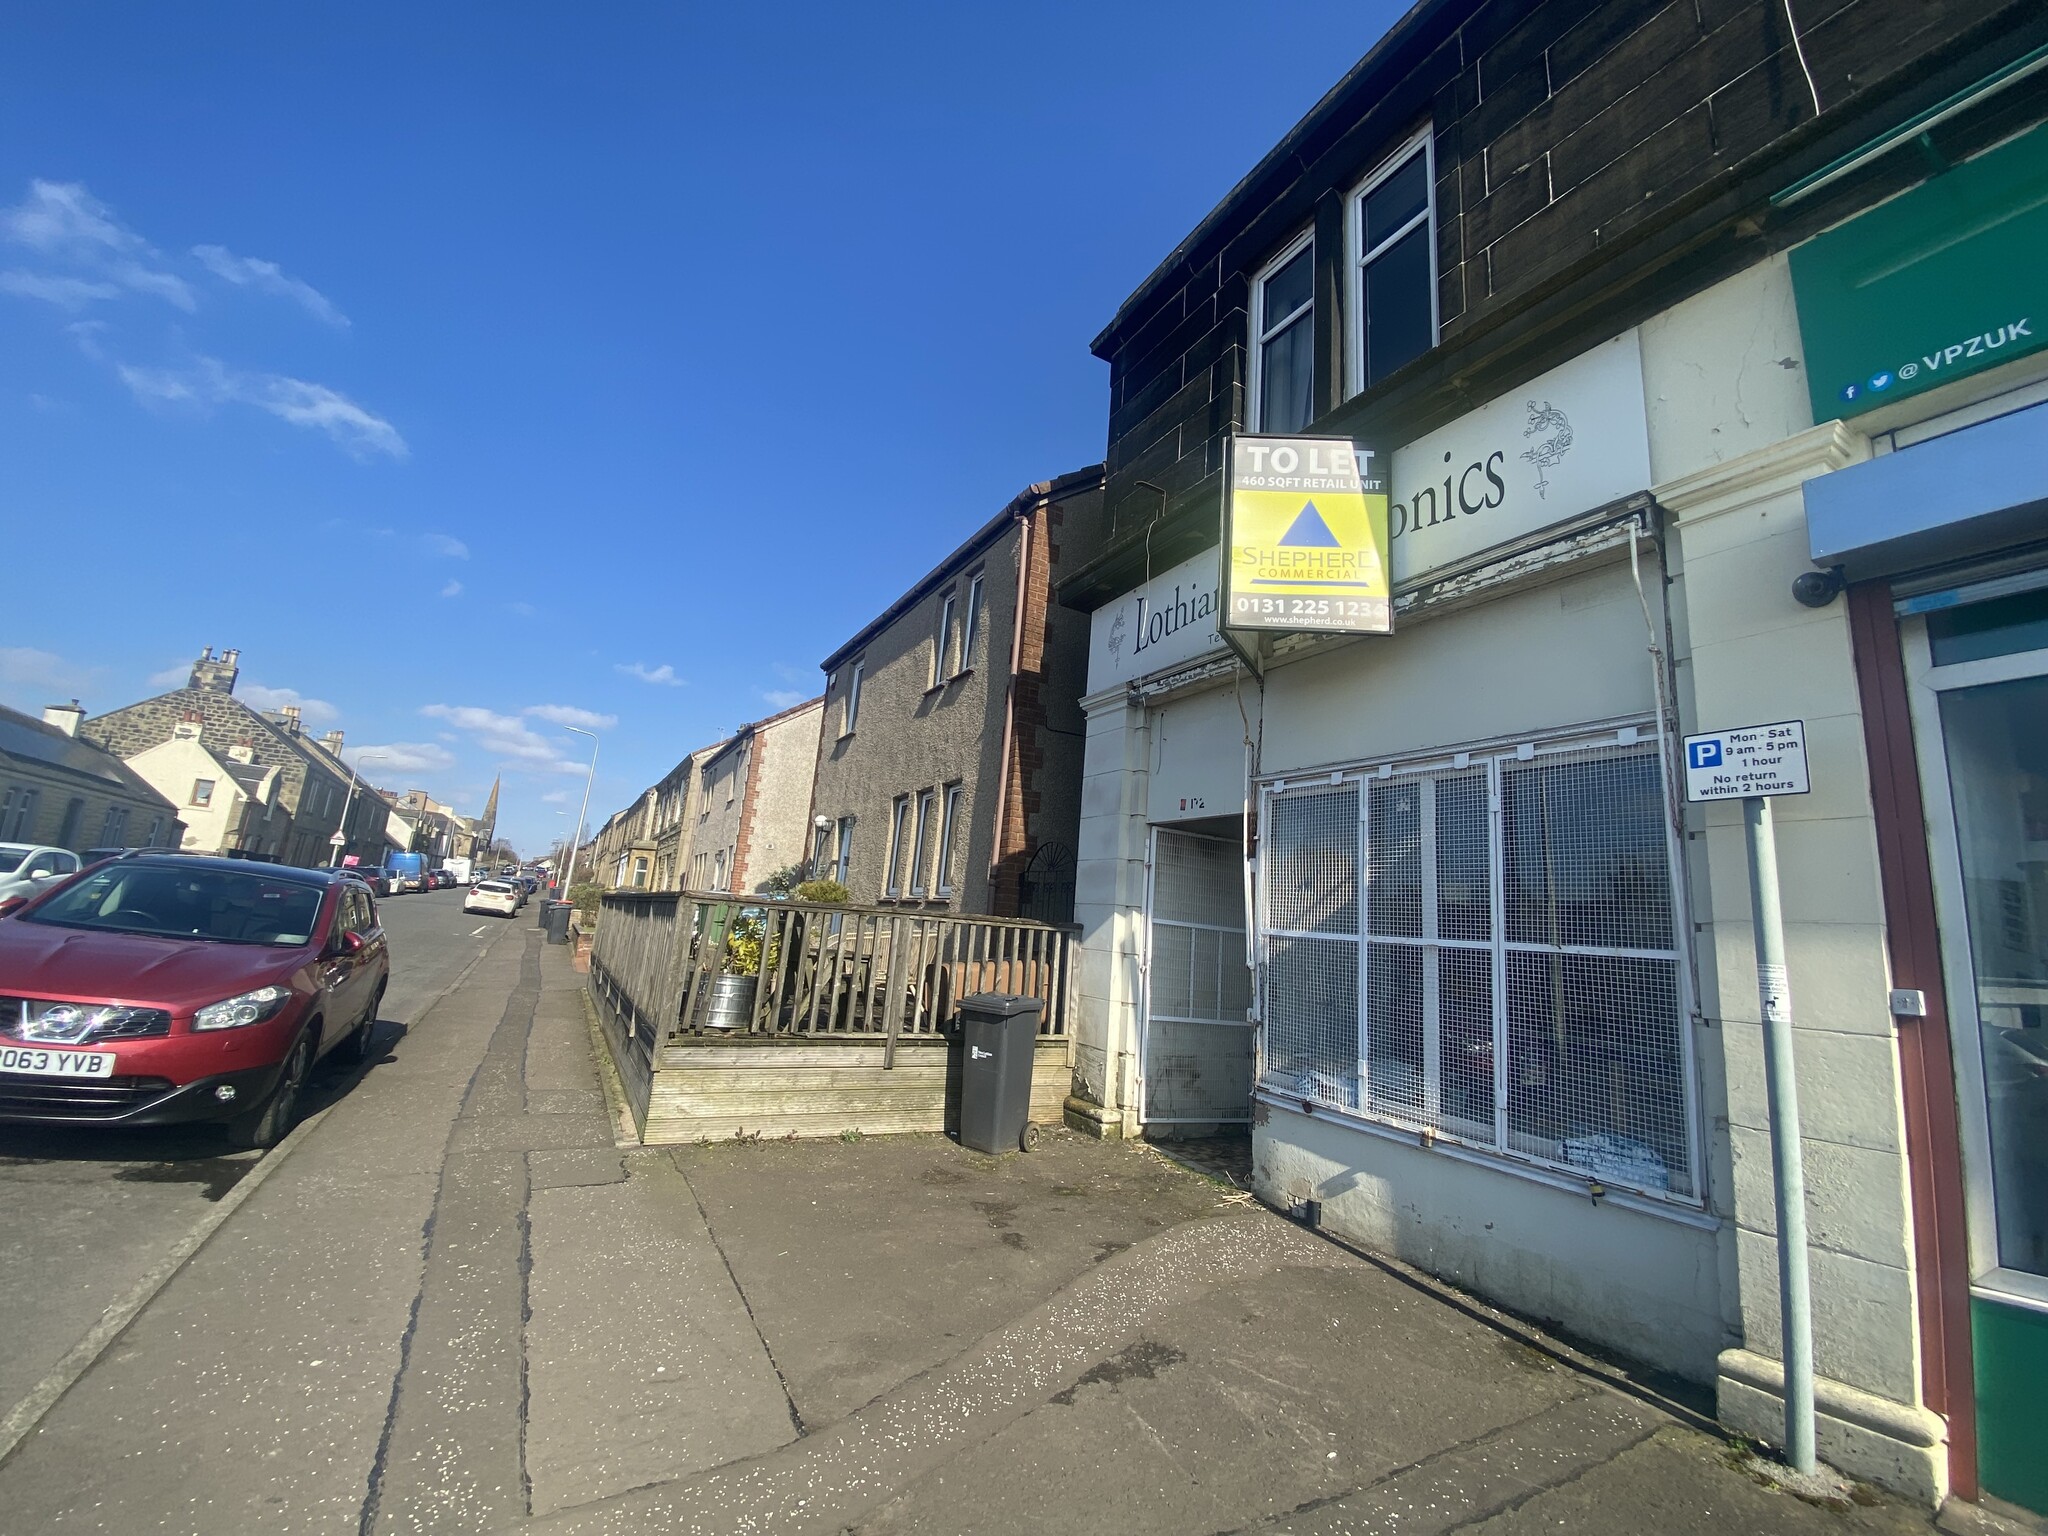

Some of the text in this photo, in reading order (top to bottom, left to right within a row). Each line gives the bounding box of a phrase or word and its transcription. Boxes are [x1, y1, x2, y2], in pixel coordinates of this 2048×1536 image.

[1247, 446, 1375, 476] TO LET
[1242, 476, 1381, 490] 460 SQFT RETAIL UNIT
[1242, 547, 1376, 569] SHEPHERD
[1258, 568, 1361, 580] COMMERCIAL
[1237, 598, 1385, 617] 0131 225 1234
[1264, 616, 1356, 627] www.shepherd.co.uk
[1207, 633, 1223, 645] Te
[1730, 733, 1757, 743] Mon
[1768, 728, 1792, 739] Sat
[1696, 743, 1716, 766] P
[1742, 756, 1782, 767] 1 hour
[1713, 772, 1777, 784] No return
[1700, 781, 1794, 796] within 2 hours
[58, 1054, 102, 1072] YVB
